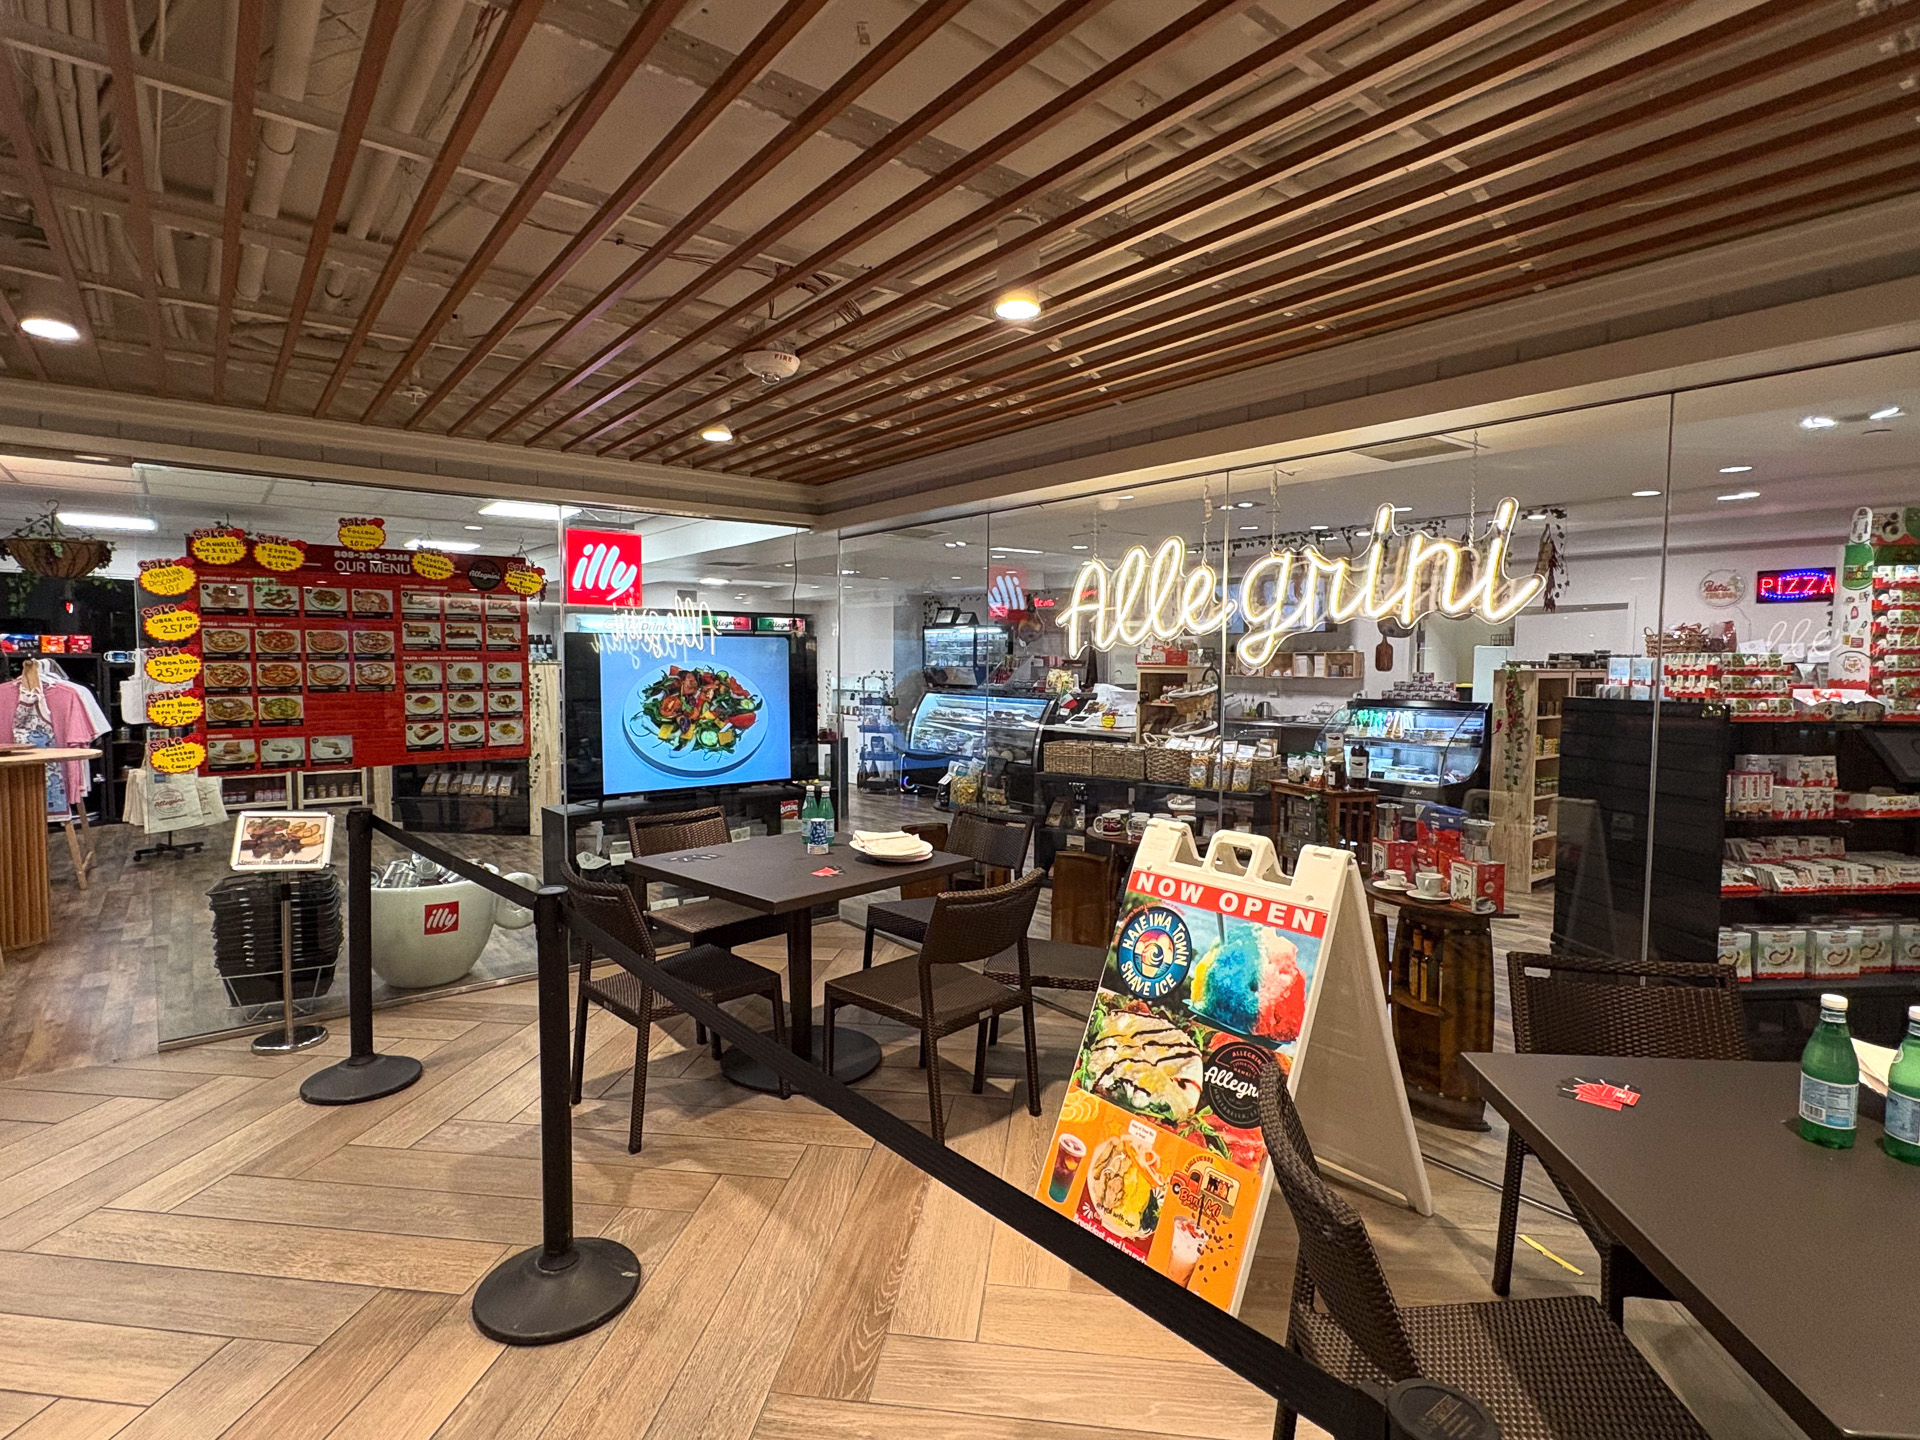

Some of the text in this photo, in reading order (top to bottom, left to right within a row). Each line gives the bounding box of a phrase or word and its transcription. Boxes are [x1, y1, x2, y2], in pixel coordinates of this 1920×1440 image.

[775, 354, 792, 362] FIRE
[334, 560, 411, 575] OUR MENU
[572, 543, 637, 601] illy
[1057, 498, 1545, 666] Allegrini
[1760, 575, 1835, 595] PIZZA
[143, 605, 176, 618] Sale
[641, 622, 674, 632] Drinks
[146, 648, 179, 659] Sale
[148, 692, 180, 703] Sale
[150, 738, 182, 752] Sale
[1136, 872, 1204, 904] NOW
[1218, 895, 1316, 933] OPEN
[426, 907, 457, 931] illy
[1172, 923, 1190, 967] TOWN
[1121, 961, 1177, 996] SHAVE ICE
[1204, 1066, 1259, 1099] Allegr
[1204, 1198, 1223, 1217] Mi
